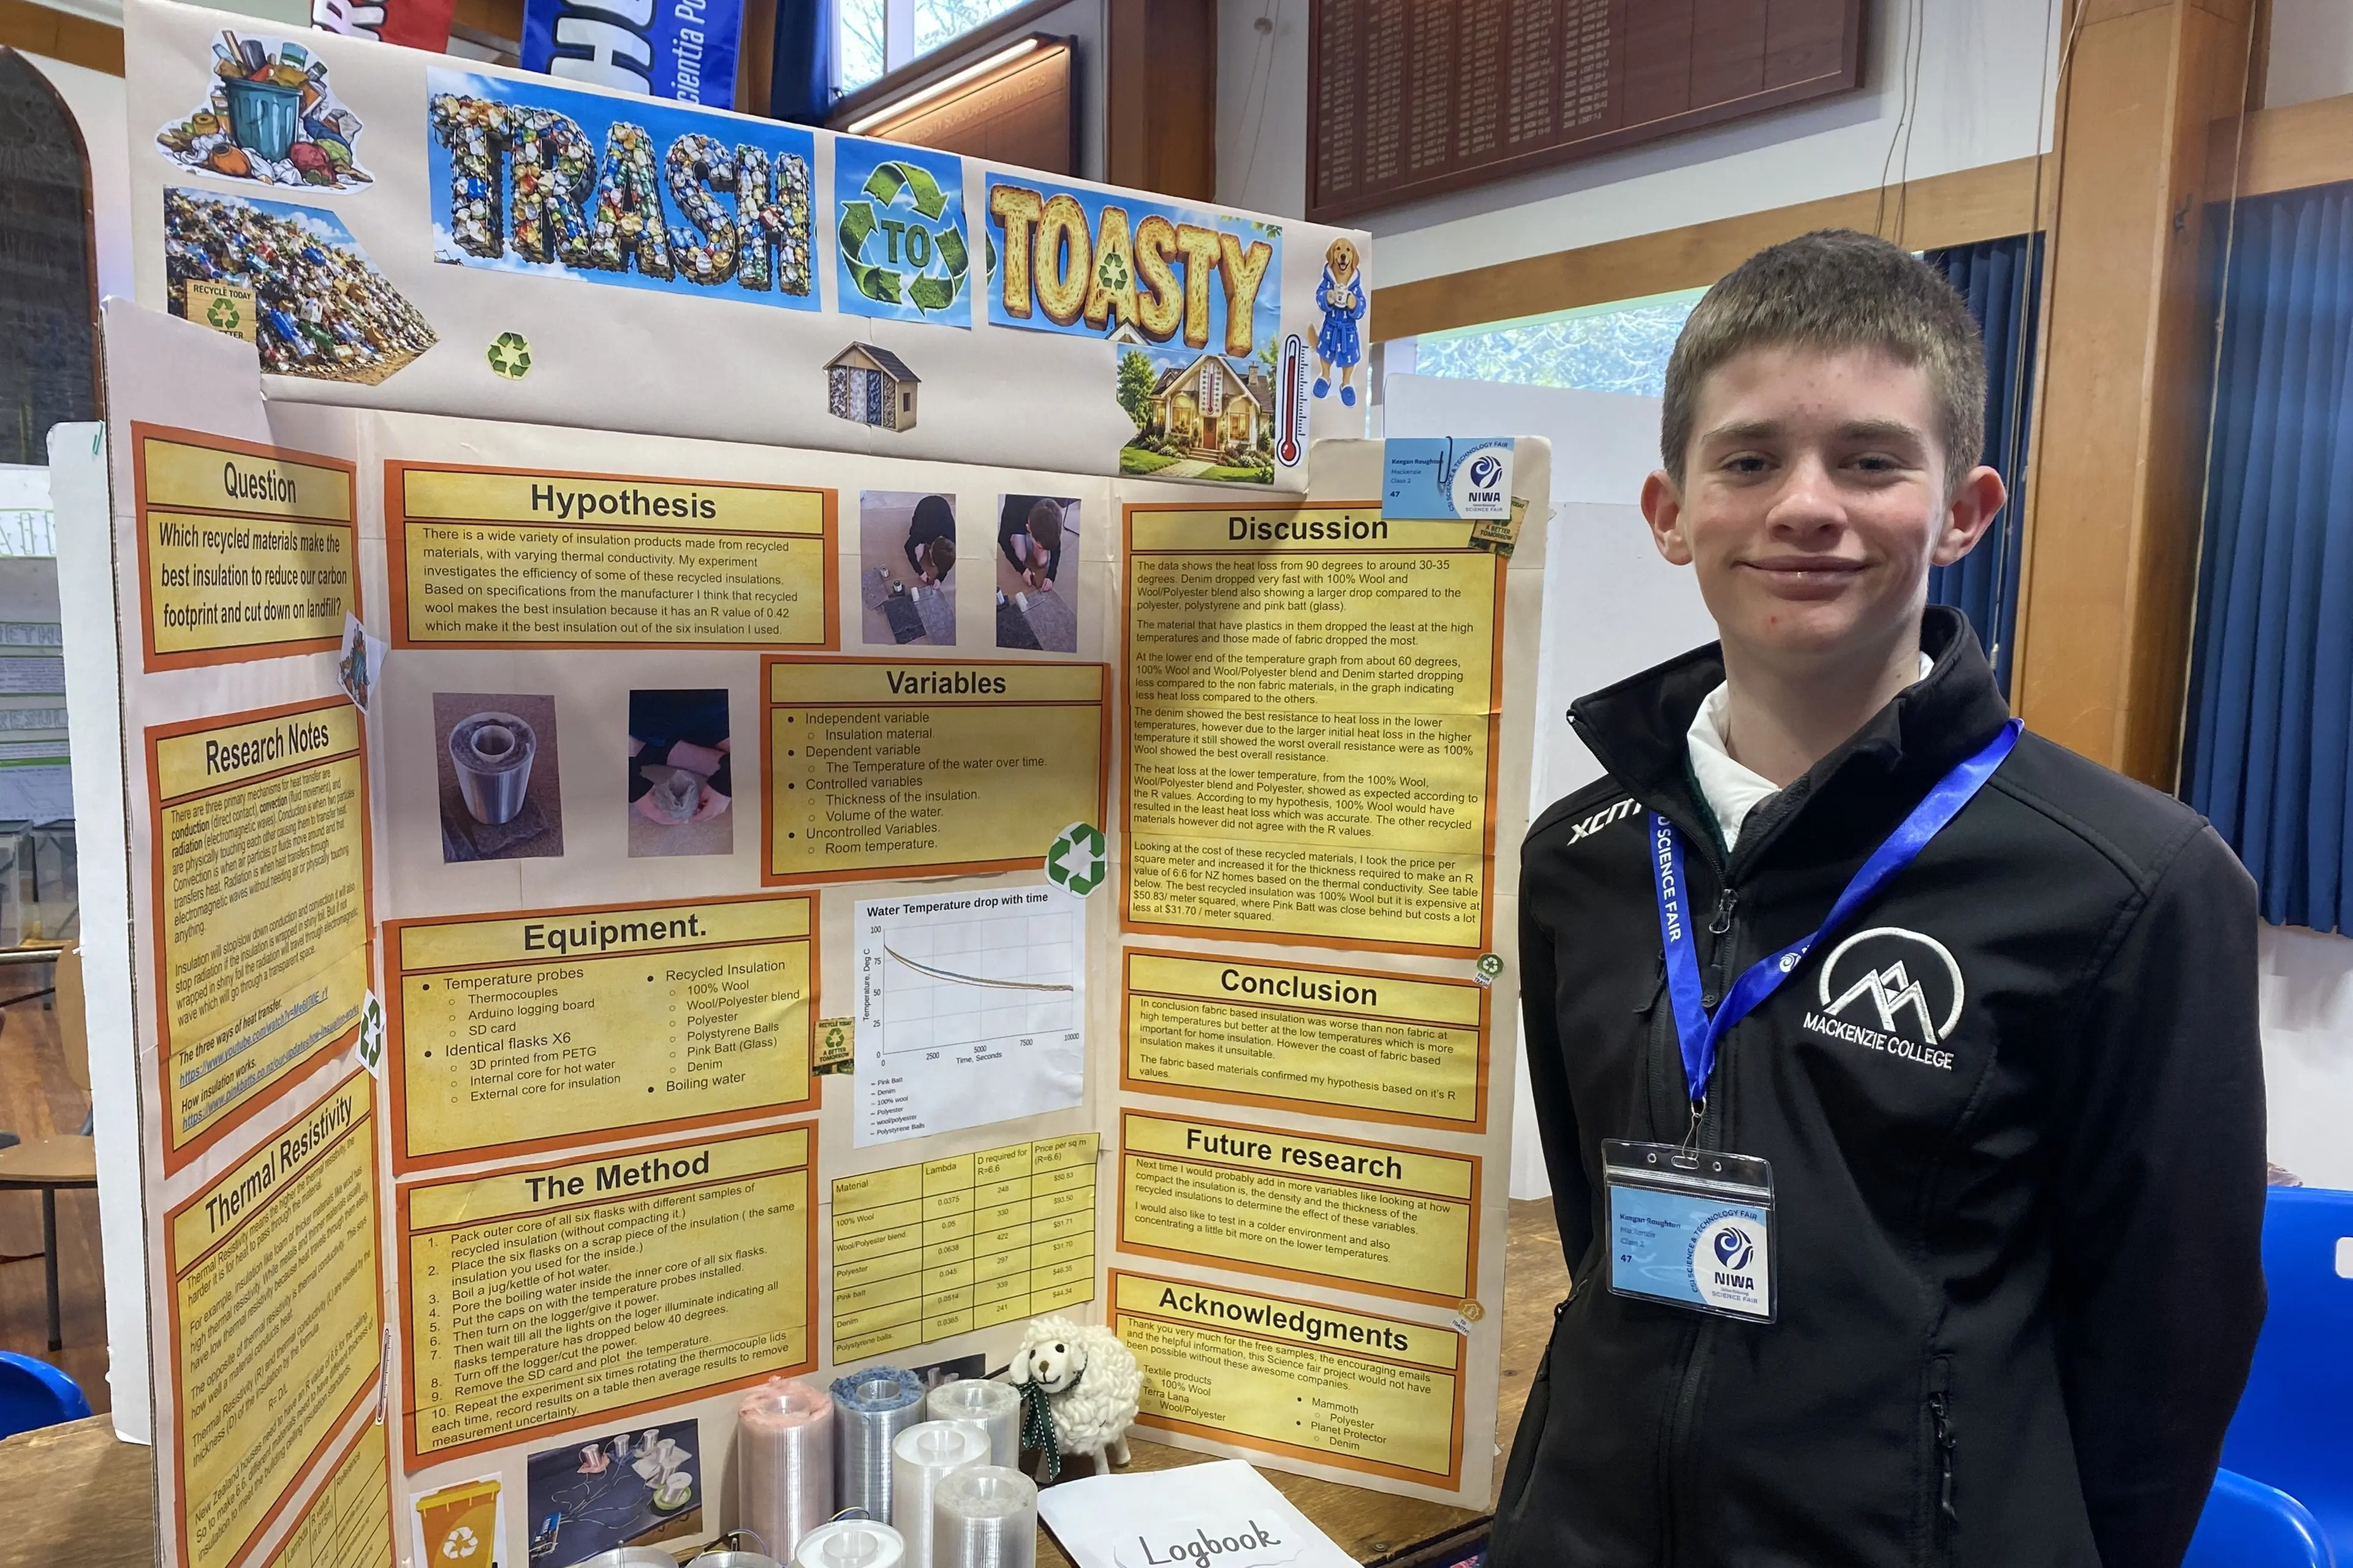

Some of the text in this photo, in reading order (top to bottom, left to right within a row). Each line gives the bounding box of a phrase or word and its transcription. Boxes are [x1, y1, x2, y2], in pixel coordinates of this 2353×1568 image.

[670, 28, 705, 105] cientia
[429, 92, 813, 296] TRASH
[879, 221, 930, 268] TO
[990, 184, 1273, 357] TOASTY
[194, 284, 251, 299] RECYCLE TODAY
[219, 330, 243, 339] TTER
[224, 461, 296, 503] Question
[1446, 472, 1455, 501] SCIENCE
[1454, 442, 1492, 469] TECHNOLOGY
[531, 484, 716, 520] Hypothesis
[1469, 492, 1500, 502] NIWA
[160, 522, 339, 554] Which recycled materials make the
[1229, 516, 1389, 540] Discussion
[1480, 529, 1512, 541] TOMORROW
[1491, 526, 1510, 534] BETTER
[423, 528, 458, 539] There
[463, 529, 472, 540] is
[488, 531, 515, 541] wide
[520, 532, 558, 545] variety
[563, 533, 573, 543] of
[577, 534, 630, 545] insulation
[635, 537, 681, 548] products
[686, 539, 714, 548] made
[719, 539, 742, 549] from
[746, 542, 789, 553] recycled
[162, 563, 346, 586] best insulation to reduce our carbon
[1137, 560, 1449, 572] The data shows the heat loss from 90 degrees to around 30-35
[164, 597, 341, 631] footprint and cut down on landfill?
[0, 625, 63, 644] ETH
[887, 671, 1006, 694] Variables
[806, 712, 929, 726] Independent variable
[826, 728, 934, 740] Insulation material.
[206, 722, 328, 776] Research Notes
[806, 776, 922, 790] Controlled variables
[826, 839, 937, 854] Room temperature.
[1656, 827, 1678, 901] SCIENCE
[867, 893, 1048, 917] Water Temperature drop with time
[525, 912, 707, 955] Equipment.
[1664, 901, 1681, 943] FAIR
[444, 968, 583, 990] Temperature probes
[667, 961, 784, 984] Recycled Insulation
[468, 987, 558, 1005] Thermocouples
[688, 980, 748, 995] 100% Wool
[1221, 968, 1377, 1006] Conclusion
[687, 989, 801, 1012] Wool/Polyester blend
[688, 1013, 738, 1026] Polyester
[179, 999, 282, 1066] The three ways of heat transfer.
[446, 1032, 570, 1056] Identical flasks X6
[1803, 1012, 1954, 1070] MACKENZIE COLLEGE
[688, 1060, 722, 1072] Denim
[976, 1052, 1002, 1061] Seconds
[182, 1059, 257, 1114] How insulation works.
[667, 1074, 746, 1096] Boiling water
[986, 1151, 1015, 1162] required
[1034, 1153, 1062, 1164] (R=6.6)
[1035, 1144, 1053, 1153] Price
[1055, 1142, 1067, 1151] per
[1186, 1128, 1403, 1180] Future research
[206, 1095, 352, 1234] Thermal Resistivity
[926, 1162, 957, 1175] Lambda
[978, 1164, 999, 1175] R=6.6
[525, 1150, 710, 1203] The Method
[836, 1180, 868, 1193] Material
[938, 1195, 960, 1206] 0.0375
[836, 1213, 874, 1227] 100% Wool
[1621, 1254, 1632, 1263] 47
[1715, 1271, 1754, 1290] NIWA
[1711, 1291, 1741, 1301] SCIENCE
[1159, 1287, 1409, 1352] Acknowledgments
[1311, 1396, 1359, 1415] Mammoth
[1310, 1421, 1387, 1444] Planet Protector
[1139, 1520, 1281, 1568] Logbook
